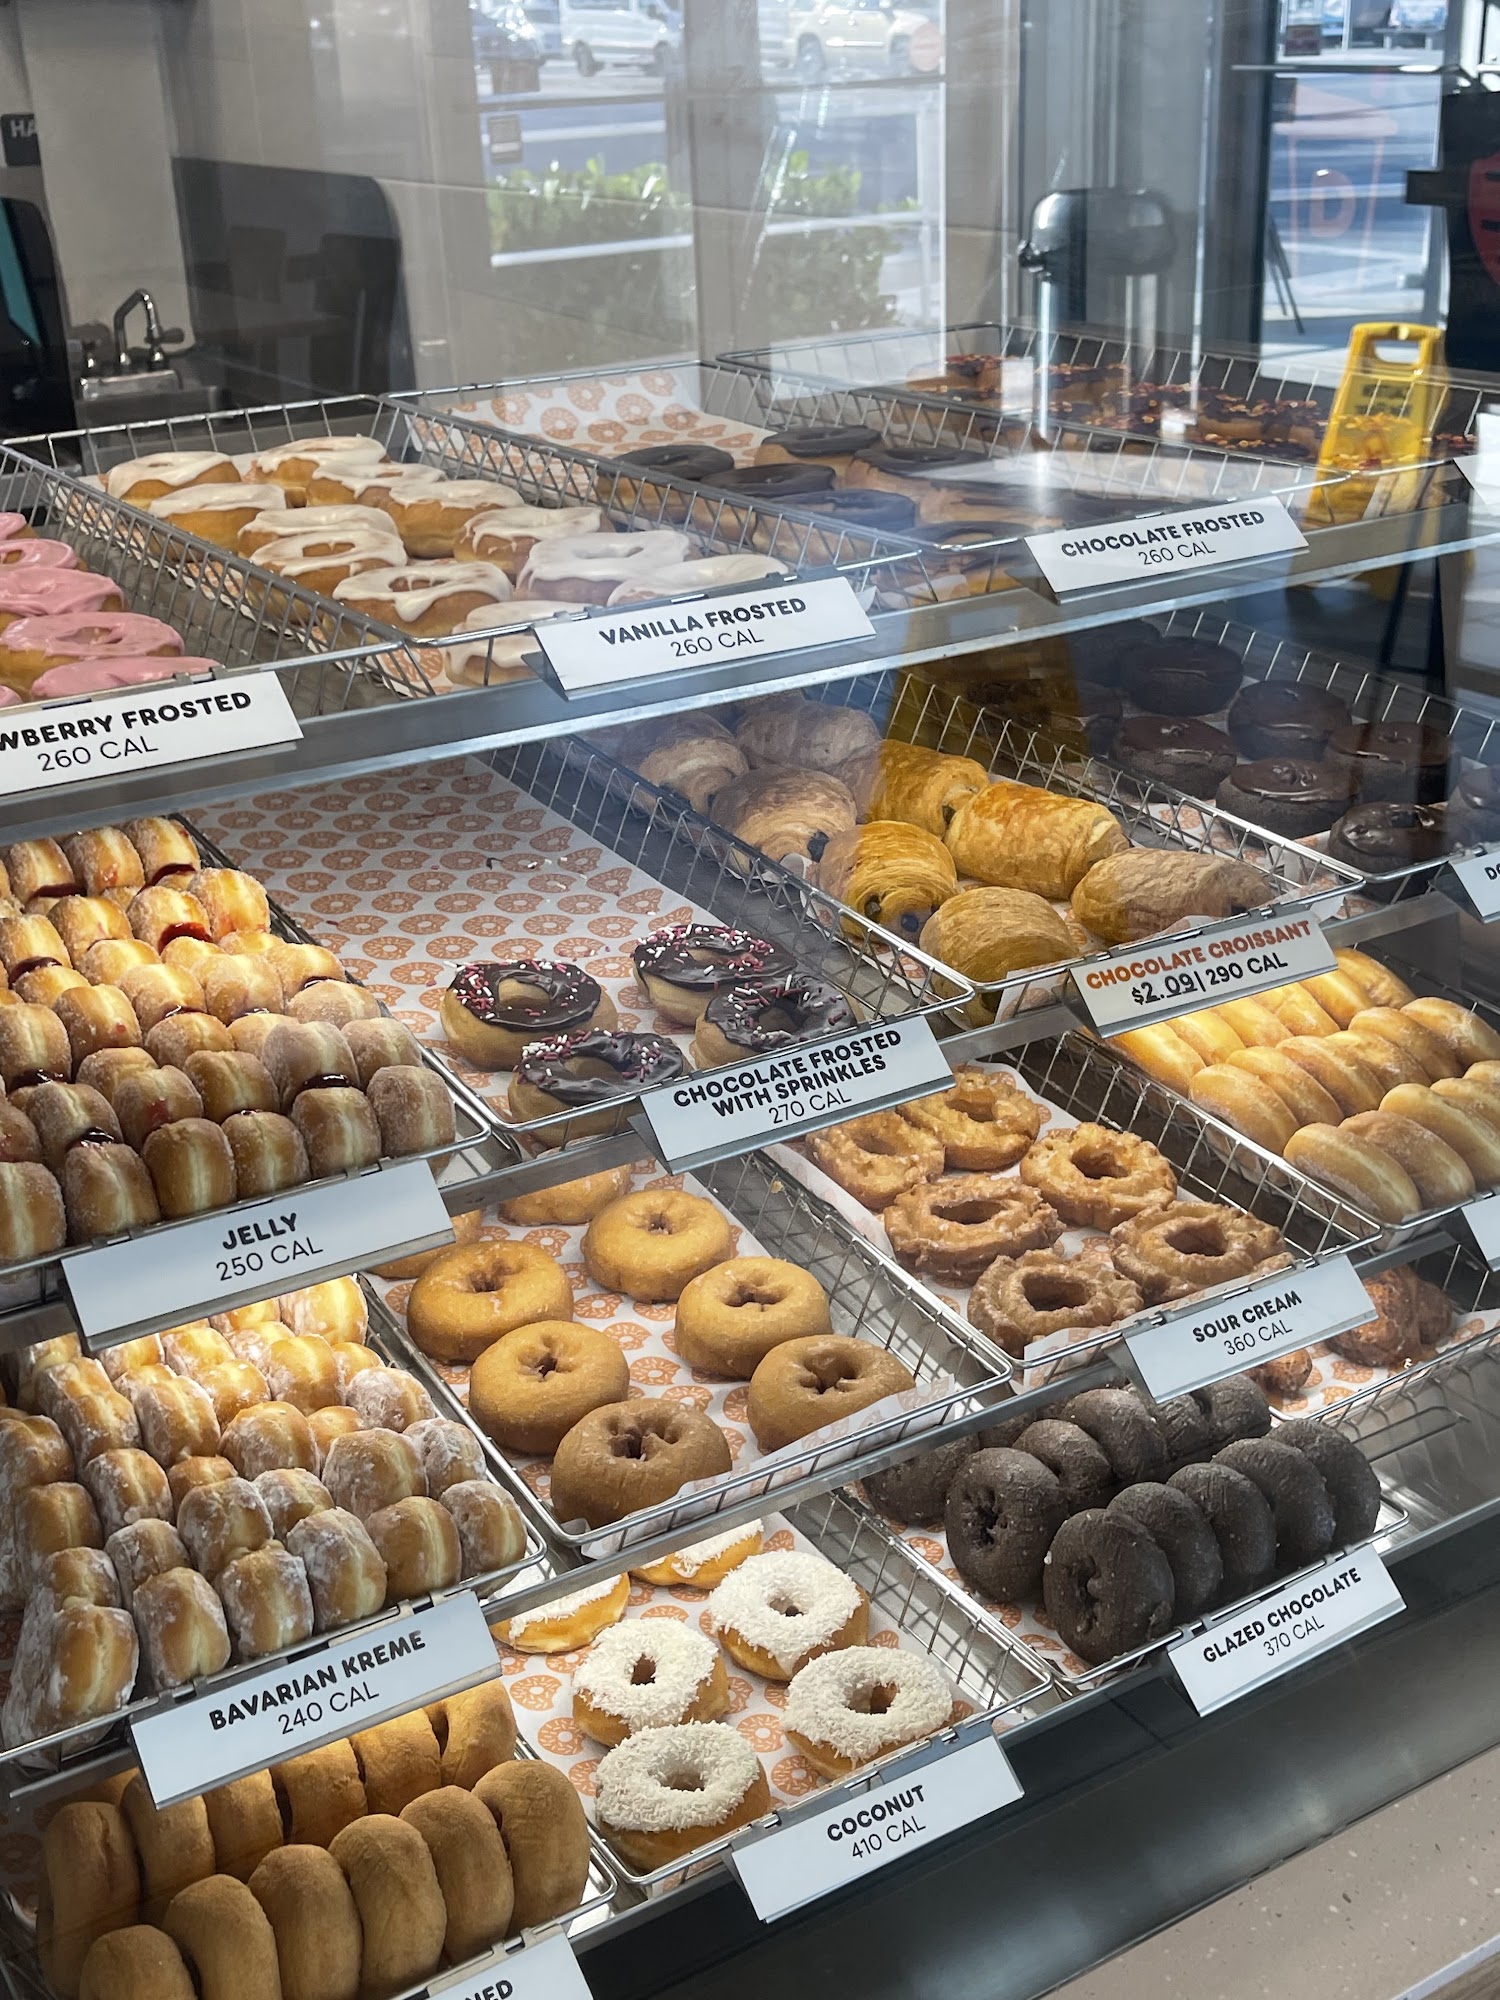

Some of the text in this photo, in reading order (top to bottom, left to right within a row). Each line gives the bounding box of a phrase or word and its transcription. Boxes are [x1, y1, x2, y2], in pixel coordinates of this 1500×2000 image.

[1061, 511, 1265, 557] CHOCOLATE FROSTED
[1138, 540, 1216, 565] 260 CAL
[599, 598, 807, 645] VANILLA FROSTED
[670, 627, 765, 657] 260 CAL
[122, 692, 251, 729] FROSTED
[37, 735, 159, 772] 260 CAL
[1086, 920, 1311, 989] CHOCOLATE CROISSANT
[1247, 952, 1288, 975] CAL
[673, 1030, 901, 1107] CHOCOLATE FROSTED
[711, 1054, 887, 1117] WITH SPRINKLES
[768, 1088, 852, 1124] 270 CAL
[222, 1212, 297, 1250] JELLY
[216, 1236, 323, 1281] 250 CAL
[1192, 1290, 1302, 1343] SOUR CREAM
[1223, 1319, 1293, 1355] 360 CAL
[1203, 1567, 1362, 1662] GLAZED CHOCOLATE
[1263, 1615, 1325, 1656] 370 CAL
[209, 1629, 426, 1730] BAVARIAN KREME
[278, 1681, 380, 1735] 240 CAL
[827, 1784, 925, 1841] COCONUT
[852, 1815, 927, 1858] 410 CAL
